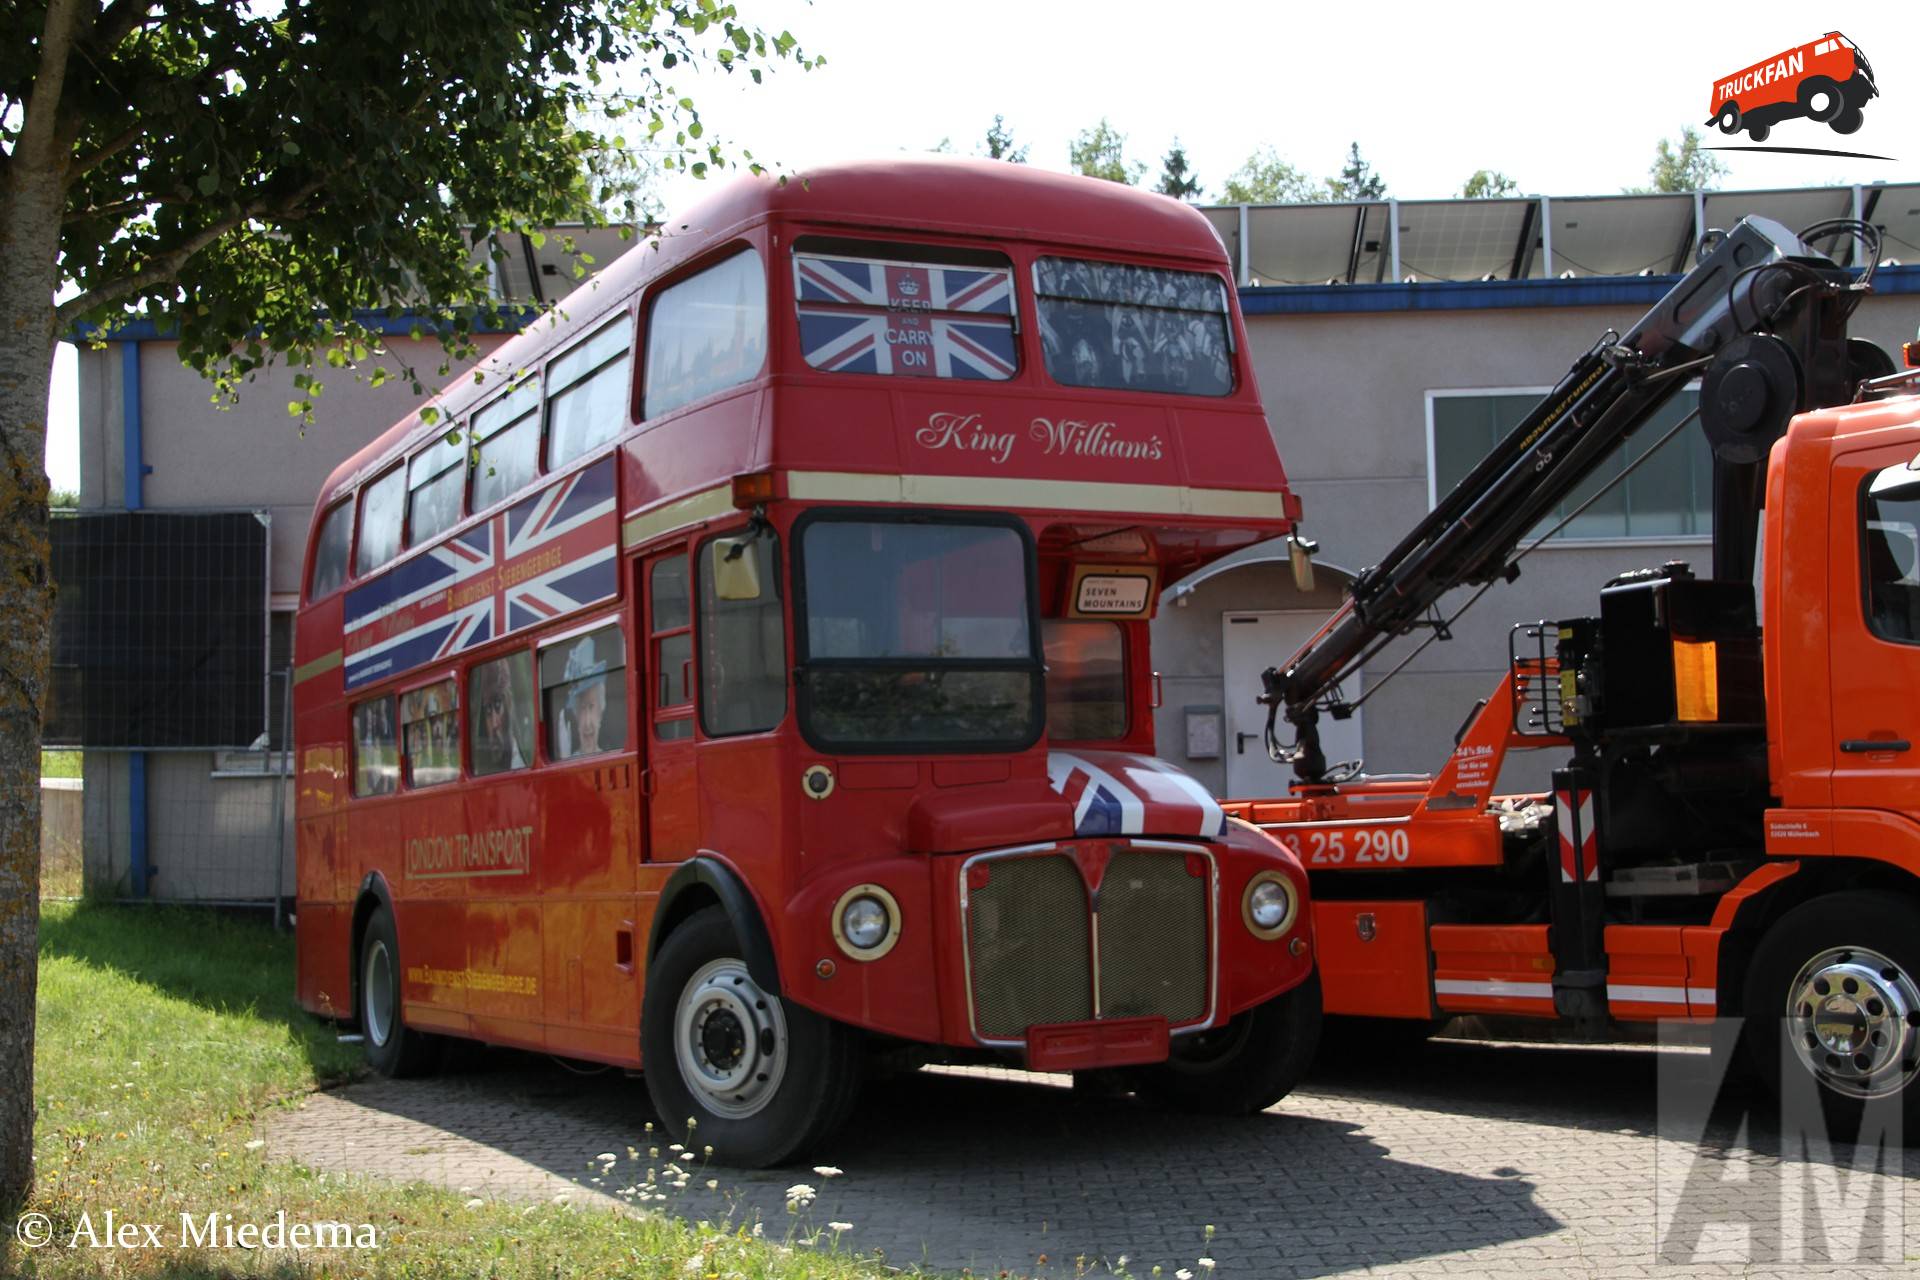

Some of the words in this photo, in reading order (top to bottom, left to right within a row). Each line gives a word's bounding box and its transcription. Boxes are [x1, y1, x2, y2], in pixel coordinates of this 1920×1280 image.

[885, 328, 935, 345] CARRY
[902, 350, 927, 367] ON
[915, 412, 1016, 464] King
[1029, 417, 1163, 460] William's
[1085, 587, 1117, 597] SEVEN
[1083, 599, 1142, 609] MOUNTAINS
[405, 838, 453, 880] LONDON
[454, 826, 534, 874] TRANSPORT
[1311, 831, 1345, 864] 25
[1354, 828, 1410, 863] 290
